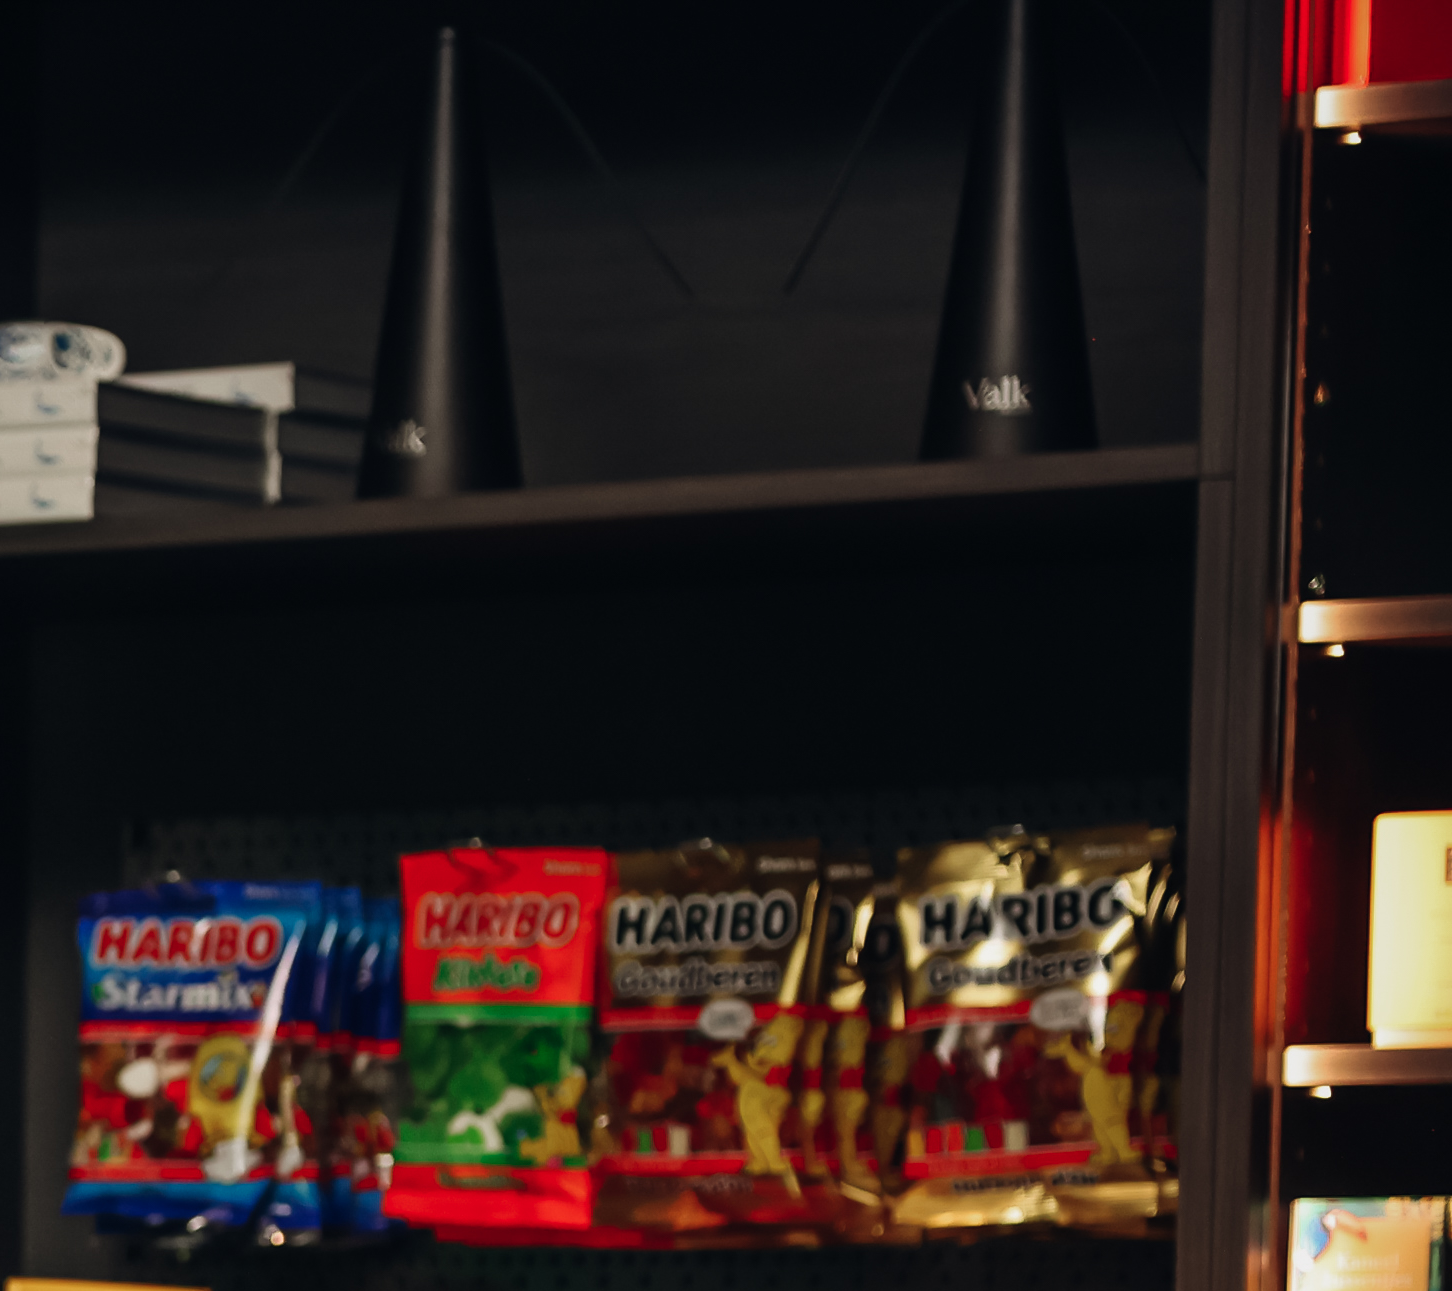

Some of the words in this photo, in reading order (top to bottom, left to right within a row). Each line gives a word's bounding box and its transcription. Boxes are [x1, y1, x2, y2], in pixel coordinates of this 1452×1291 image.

[963, 374, 1031, 413] Valk
[91, 914, 284, 967] HARIBO
[418, 892, 581, 949] HARIBO
[612, 892, 799, 950] HARIBO
[922, 879, 1129, 947] HARIBO
[98, 971, 253, 1013] Starmix
